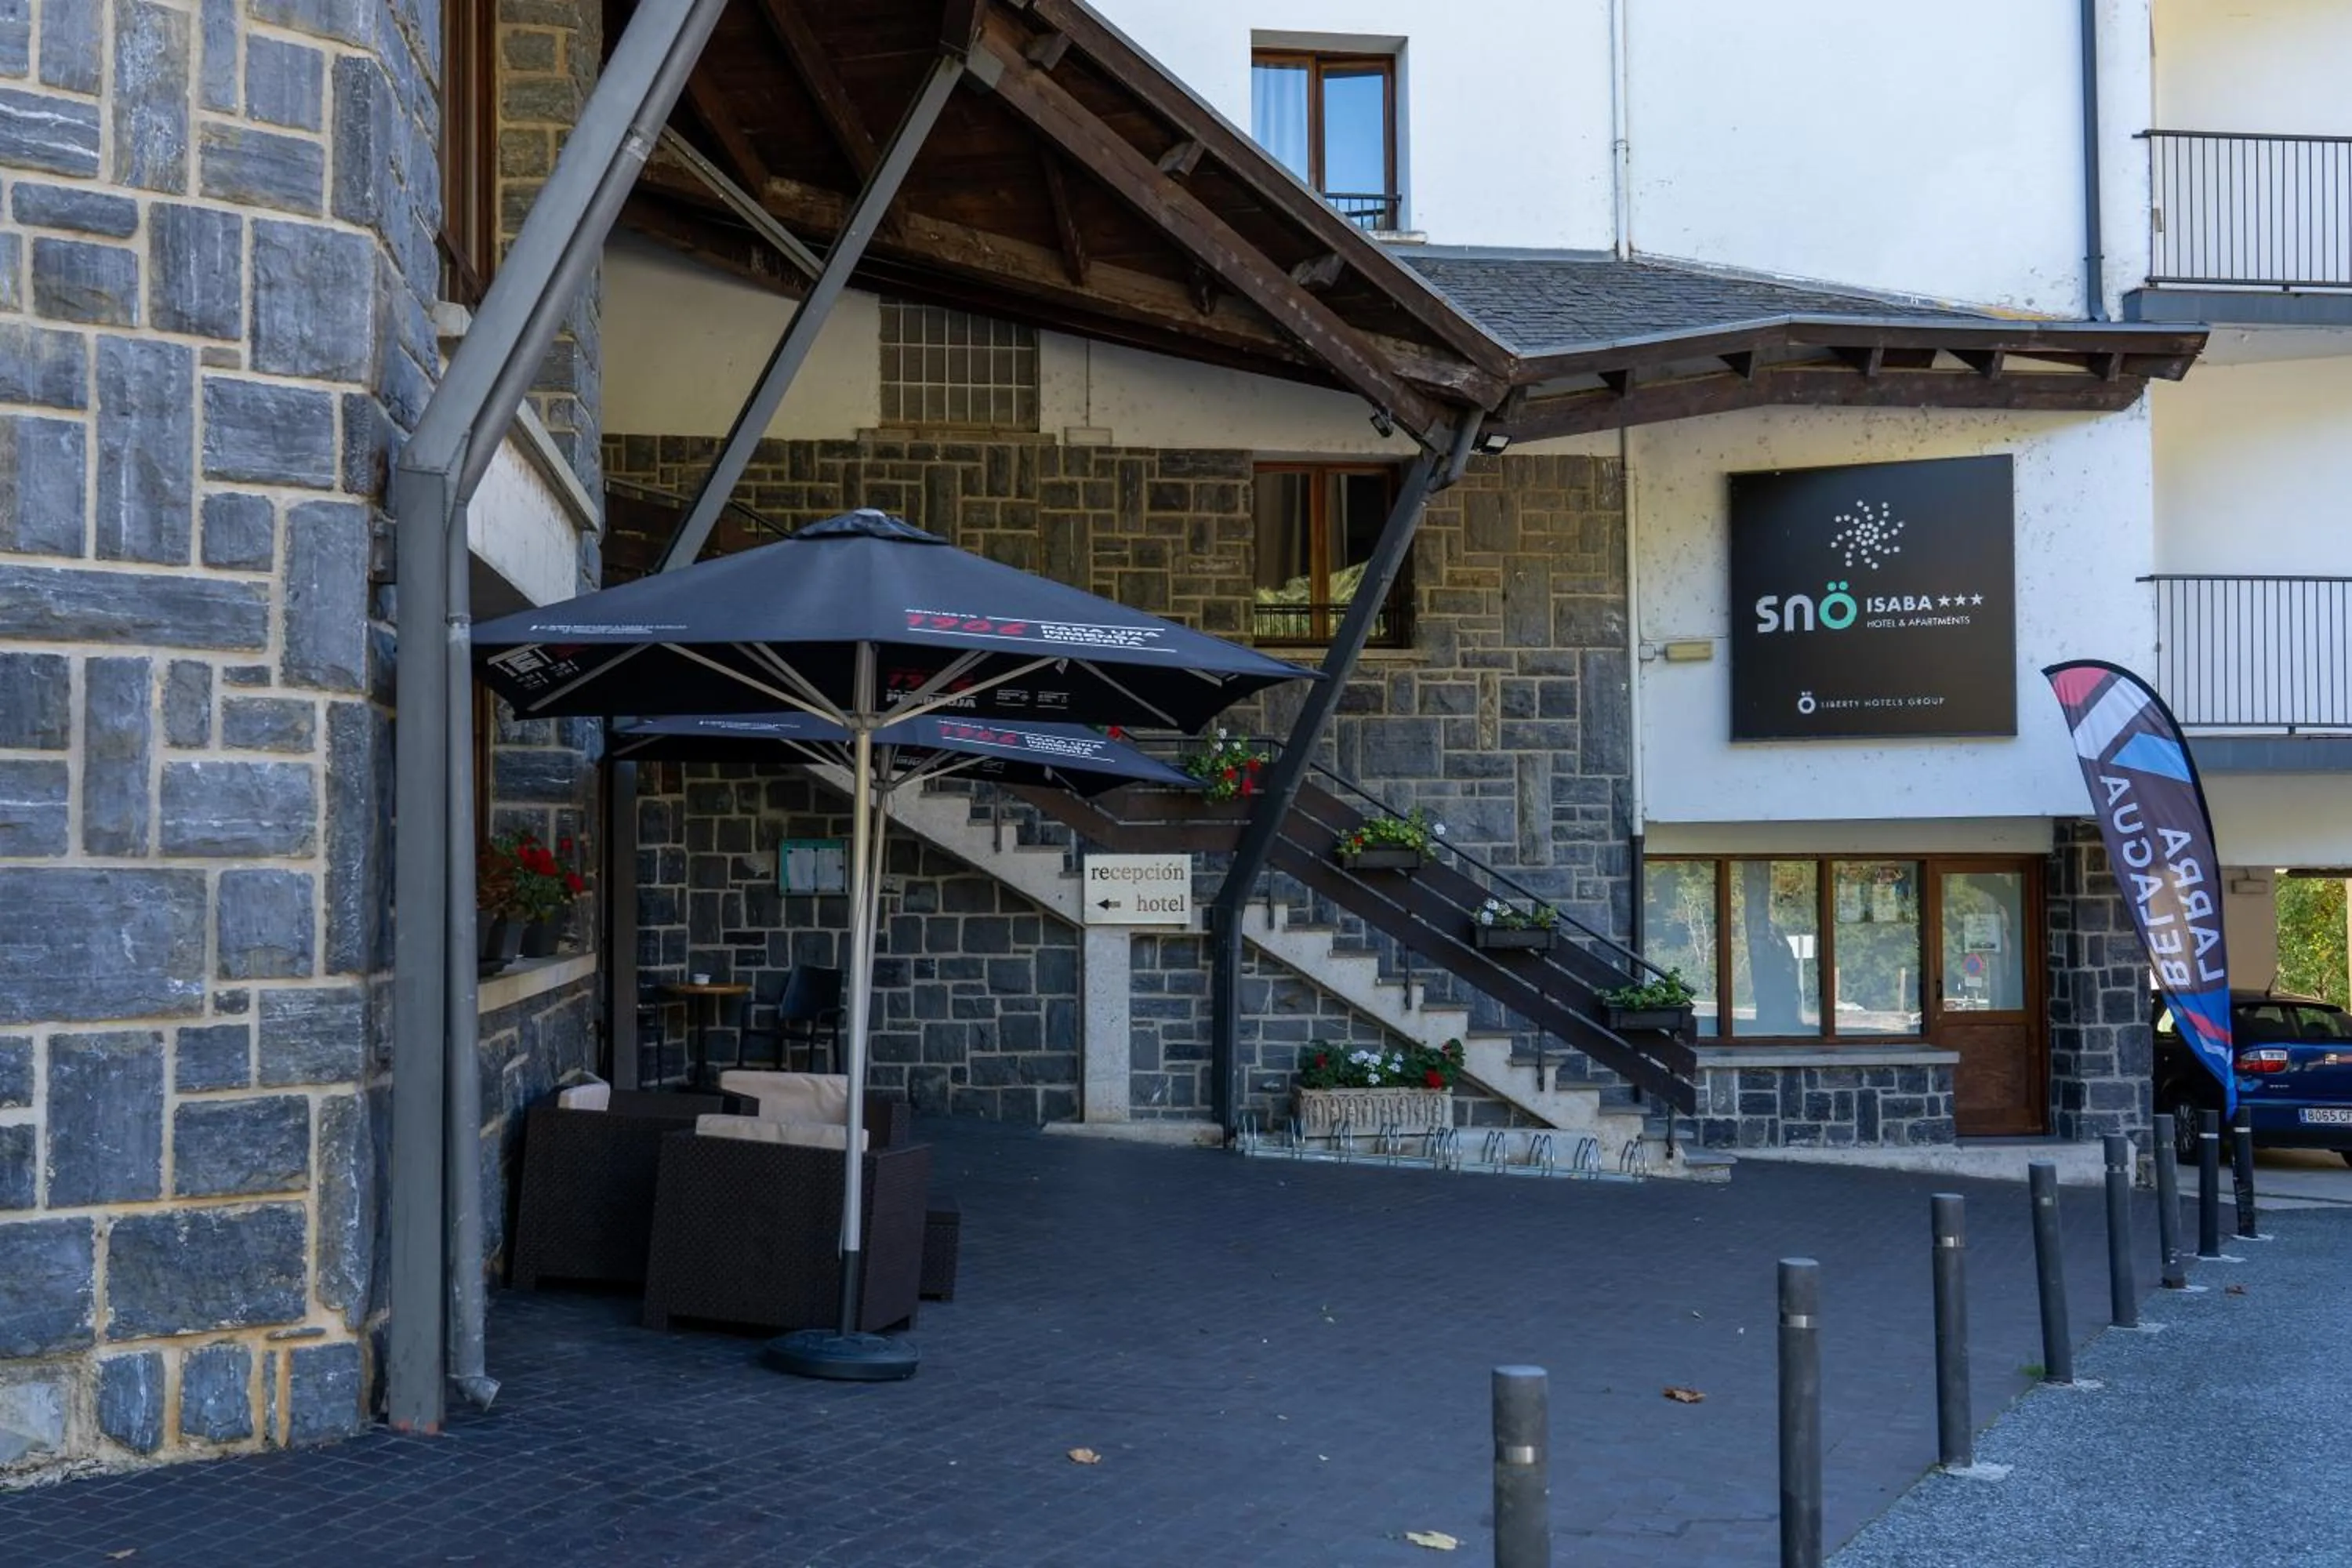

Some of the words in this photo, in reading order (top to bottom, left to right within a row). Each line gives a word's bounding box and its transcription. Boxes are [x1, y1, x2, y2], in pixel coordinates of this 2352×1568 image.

[1867, 596, 1933, 613] ISABA
[1867, 619, 1896, 628] HOTEL
[1898, 619, 1906, 627] &
[1907, 615, 1970, 626] APARTMENTS
[1041, 625, 1105, 634] PARA
[1865, 699, 1903, 707] HOTELS
[1091, 862, 1185, 885] recepción
[1136, 894, 1185, 912] hotel
